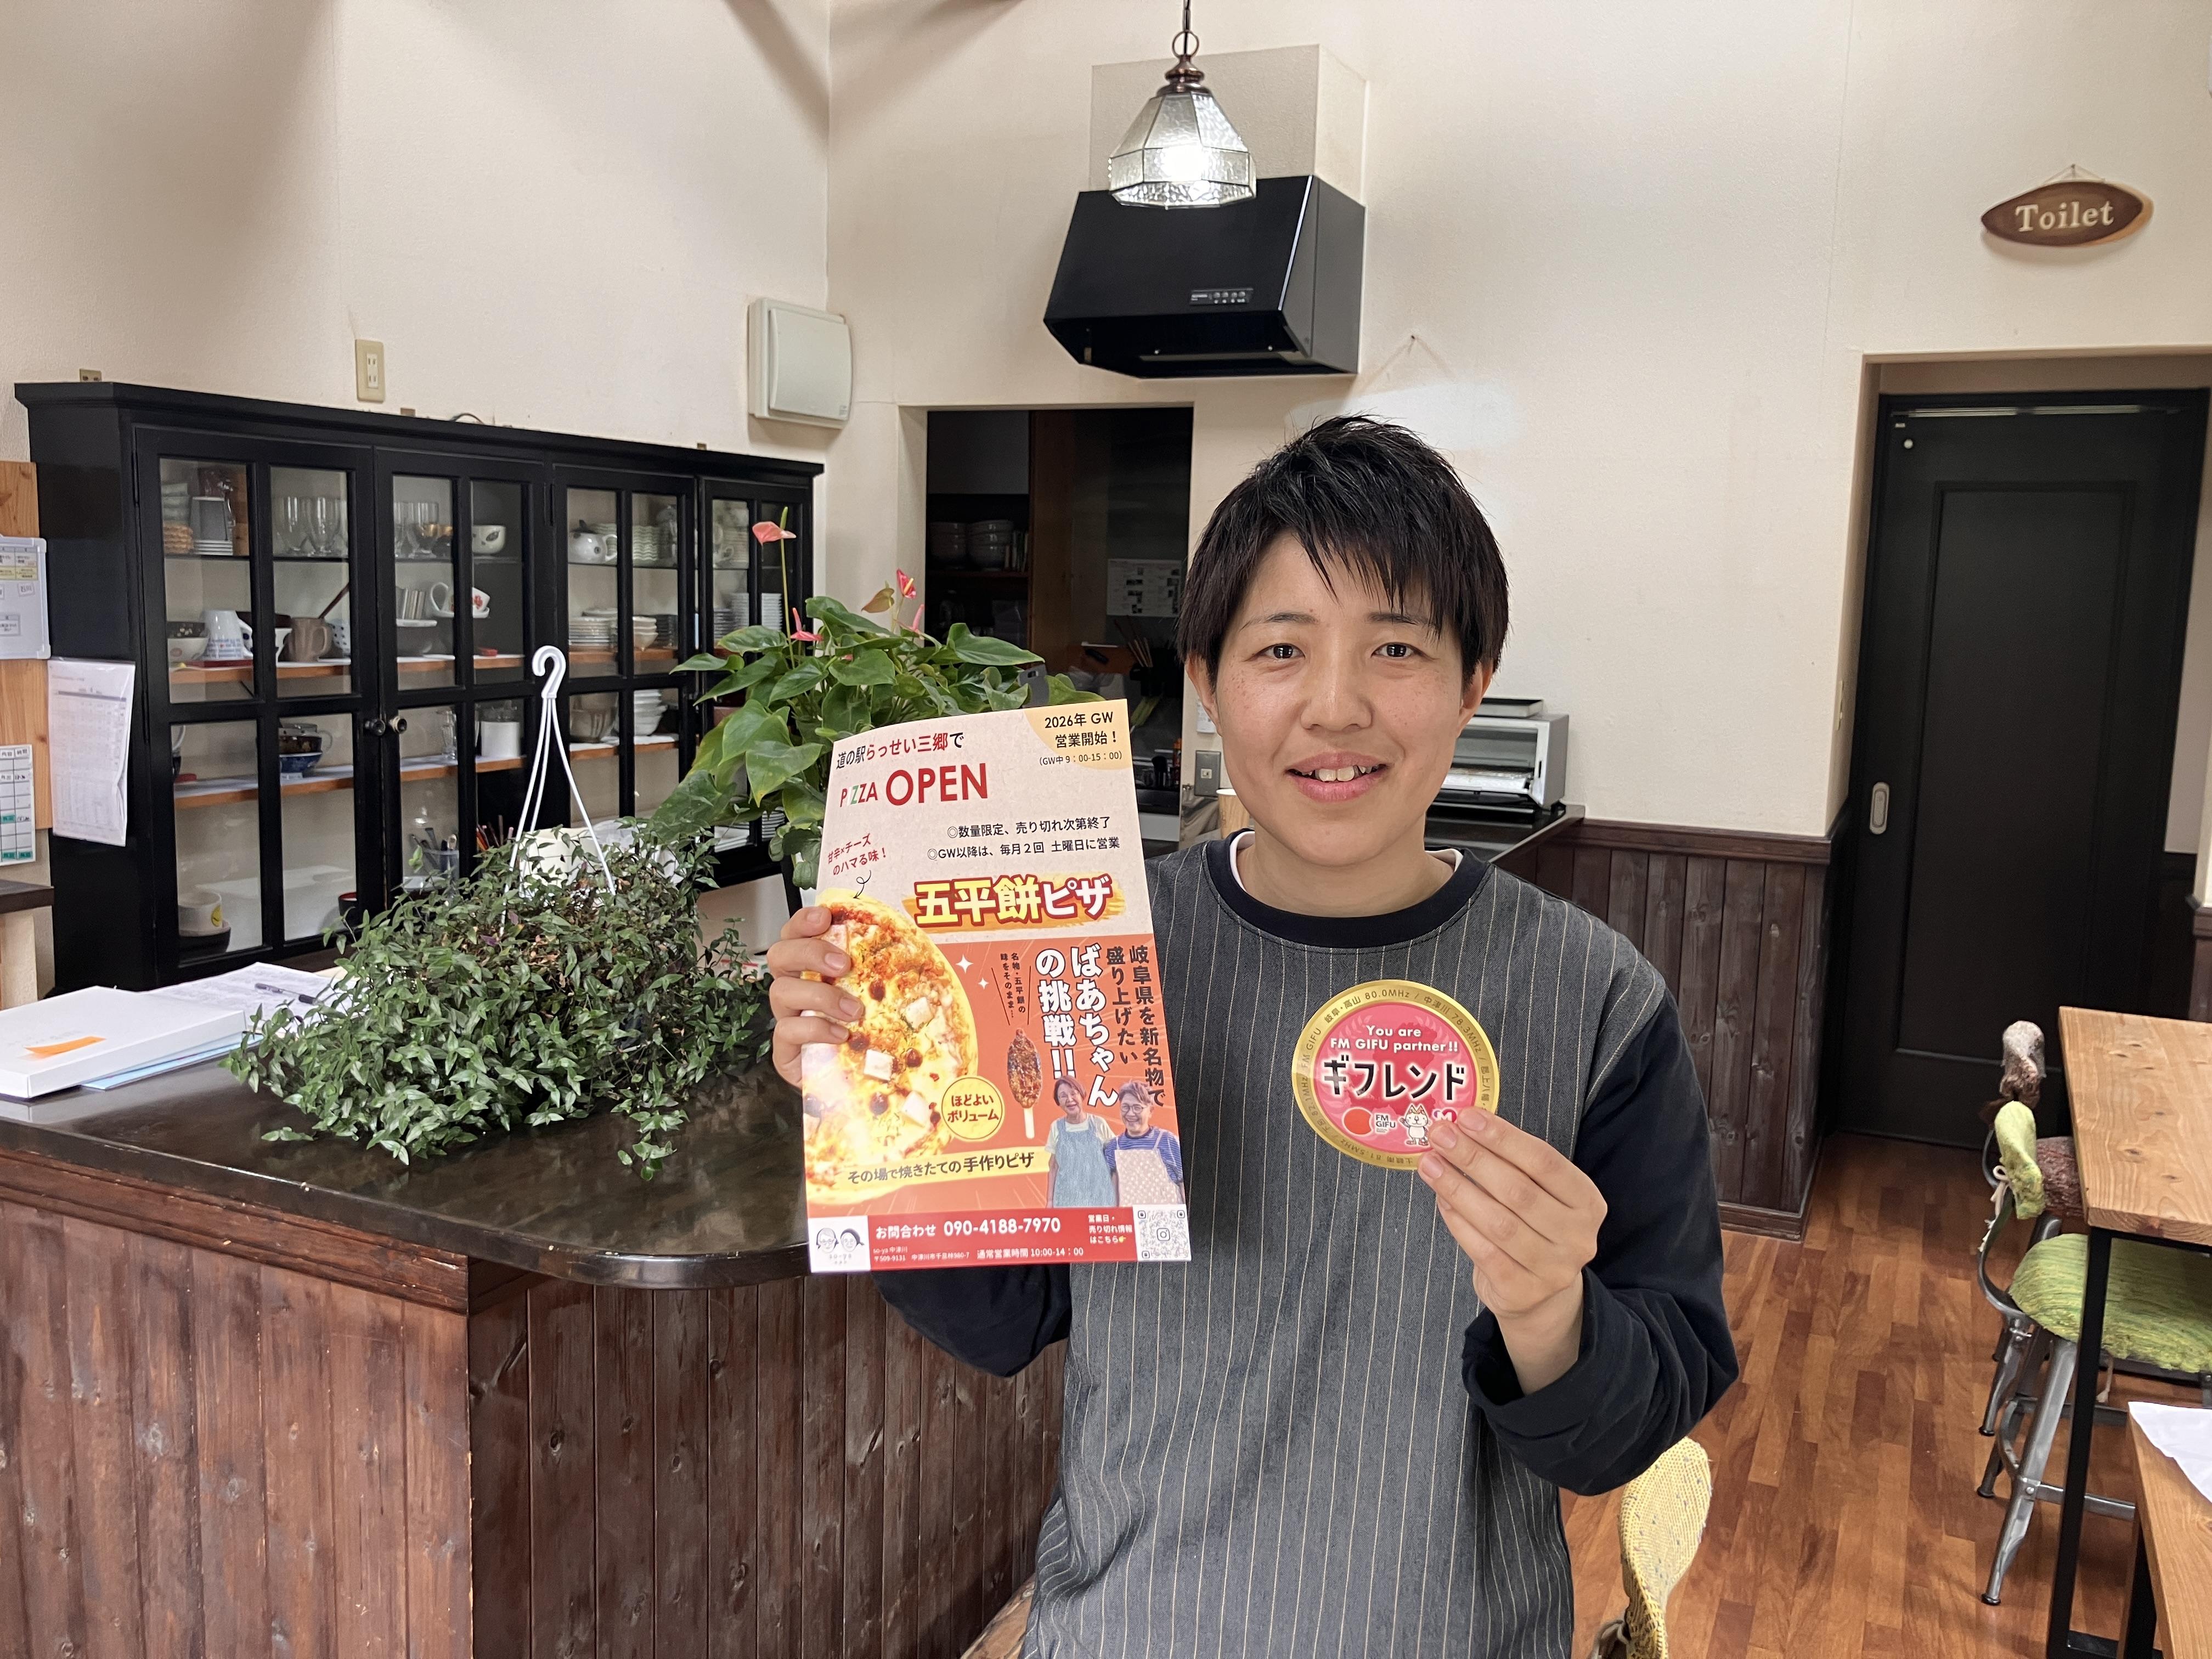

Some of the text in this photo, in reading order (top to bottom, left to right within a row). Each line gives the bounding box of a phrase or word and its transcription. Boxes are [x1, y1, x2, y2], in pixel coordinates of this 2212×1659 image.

[2015, 201, 2114, 232] Toilet
[1045, 712, 1113, 729] 2026年 GW
[836, 732, 964, 769] 道の駅らっせい三郷で
[1056, 731, 1116, 748] 営業開始！
[840, 763, 988, 808] PIZZA OPEN
[915, 873, 1112, 927] 五平餅ピザ
[1106, 946, 1138, 1064] 盛り上げたい
[1365, 989, 1410, 1000] 80.0MHz
[1070, 943, 1118, 1107] ばあちゃん
[1130, 945, 1165, 1107] 岐阜県を新名物で
[1365, 1025, 1422, 1037] You are
[1452, 1013, 1482, 1053] 78.3MHz
[1301, 1027, 1322, 1068] FM GIFU
[1330, 1038, 1350, 1049] FM
[1356, 1038, 1389, 1050] GIFU
[1324, 1054, 1465, 1101] ギフレンド
[951, 1094, 994, 1107] ほどよい
[1301, 1076, 1318, 1116] 82.1MHz
[947, 1109, 999, 1122] ボリューム
[1340, 1138, 1382, 1160] 81.5MHz
[848, 1152, 1035, 1184] その場で焼きたての手作りピザ
[876, 1217, 1060, 1239] お問合わせ 090-4188-7970
[977, 1248, 1029, 1260] 通常営業時間
